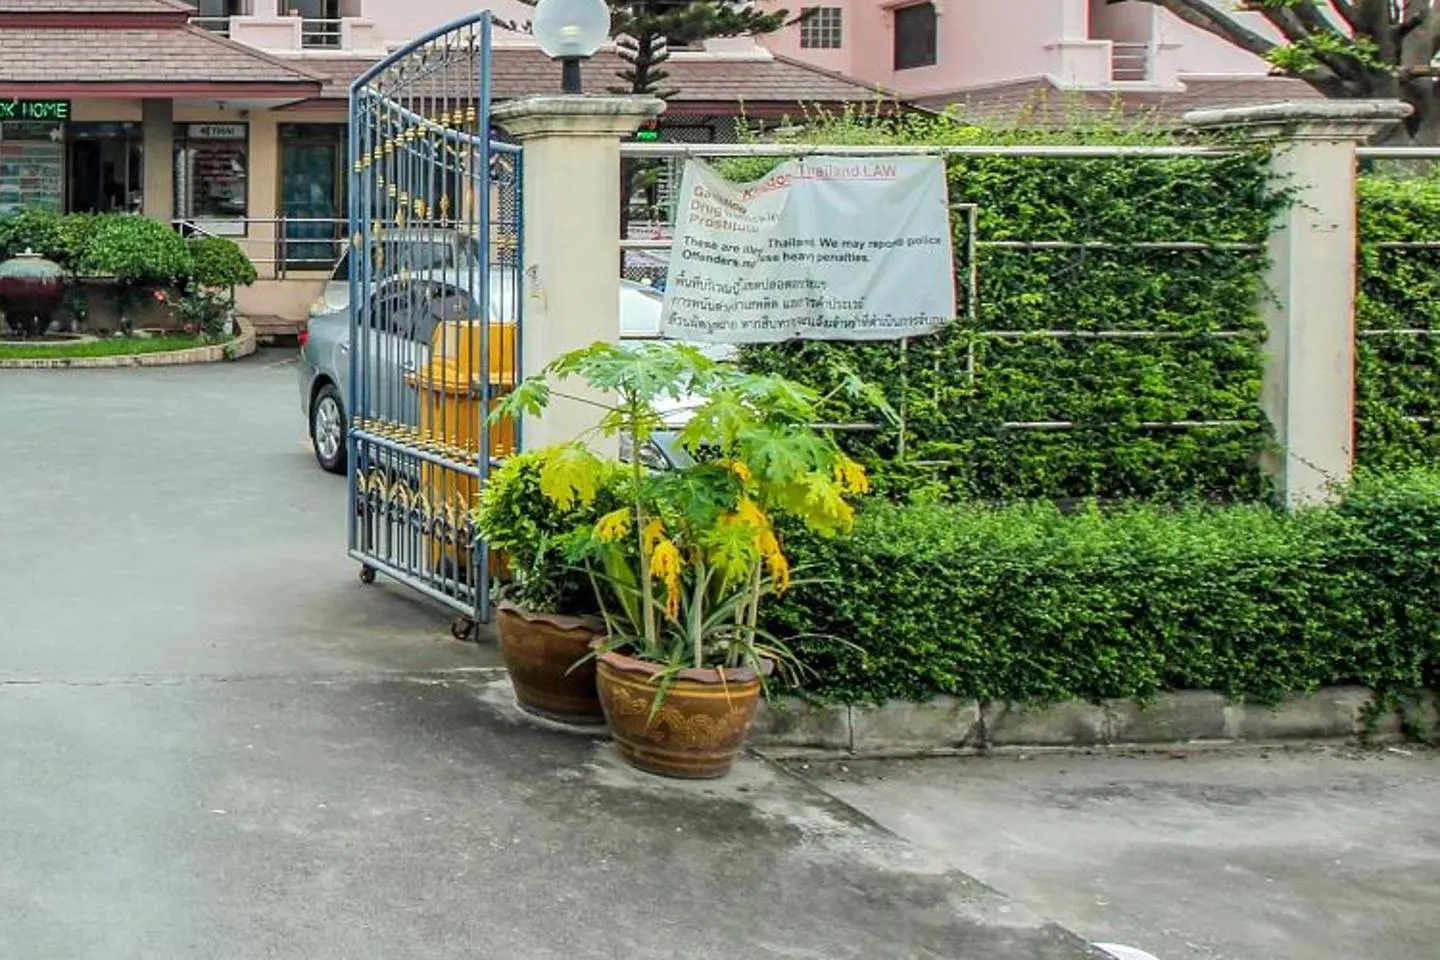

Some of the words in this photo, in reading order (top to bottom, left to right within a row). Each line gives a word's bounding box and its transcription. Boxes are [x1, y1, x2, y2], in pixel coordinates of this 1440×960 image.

[22, 103, 68, 119] HOME
[797, 162, 860, 179] Thailand
[863, 163, 897, 179] LAW
[683, 235, 719, 250] These
[819, 237, 838, 248] We
[842, 238, 866, 250] may
